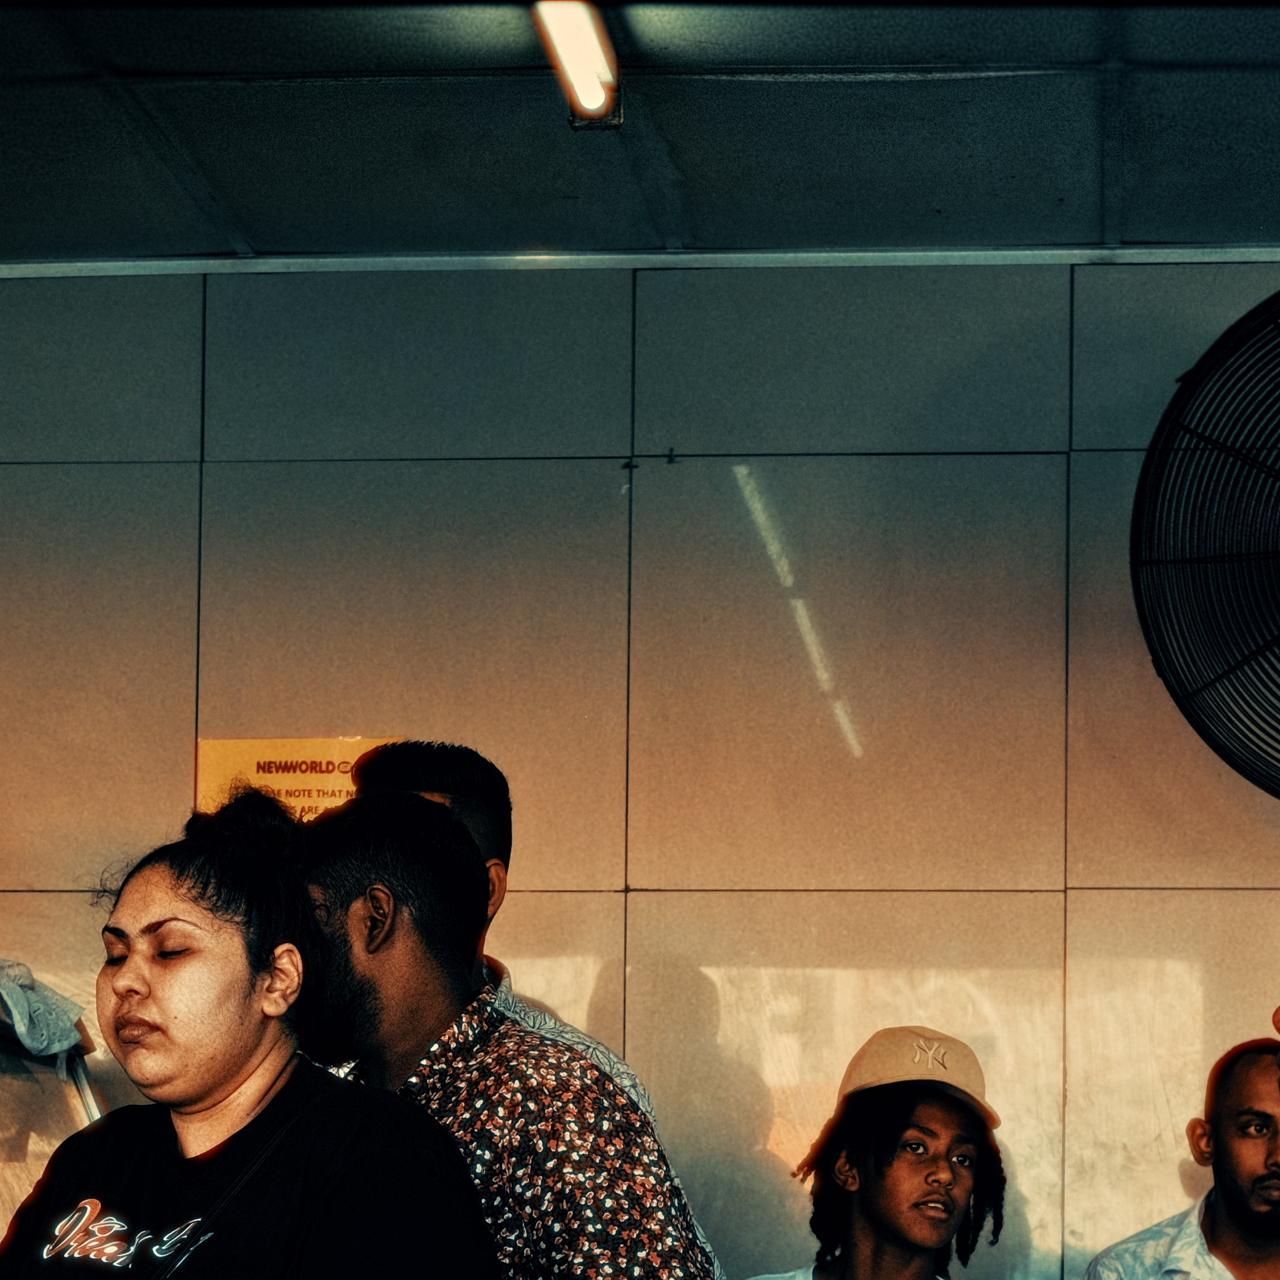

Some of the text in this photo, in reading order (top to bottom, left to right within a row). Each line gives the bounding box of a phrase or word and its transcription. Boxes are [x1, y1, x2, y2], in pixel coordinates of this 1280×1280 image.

[256, 761, 335, 774] NEWWORLD
[285, 789, 312, 798] NOTE
[316, 789, 344, 798] THAT
